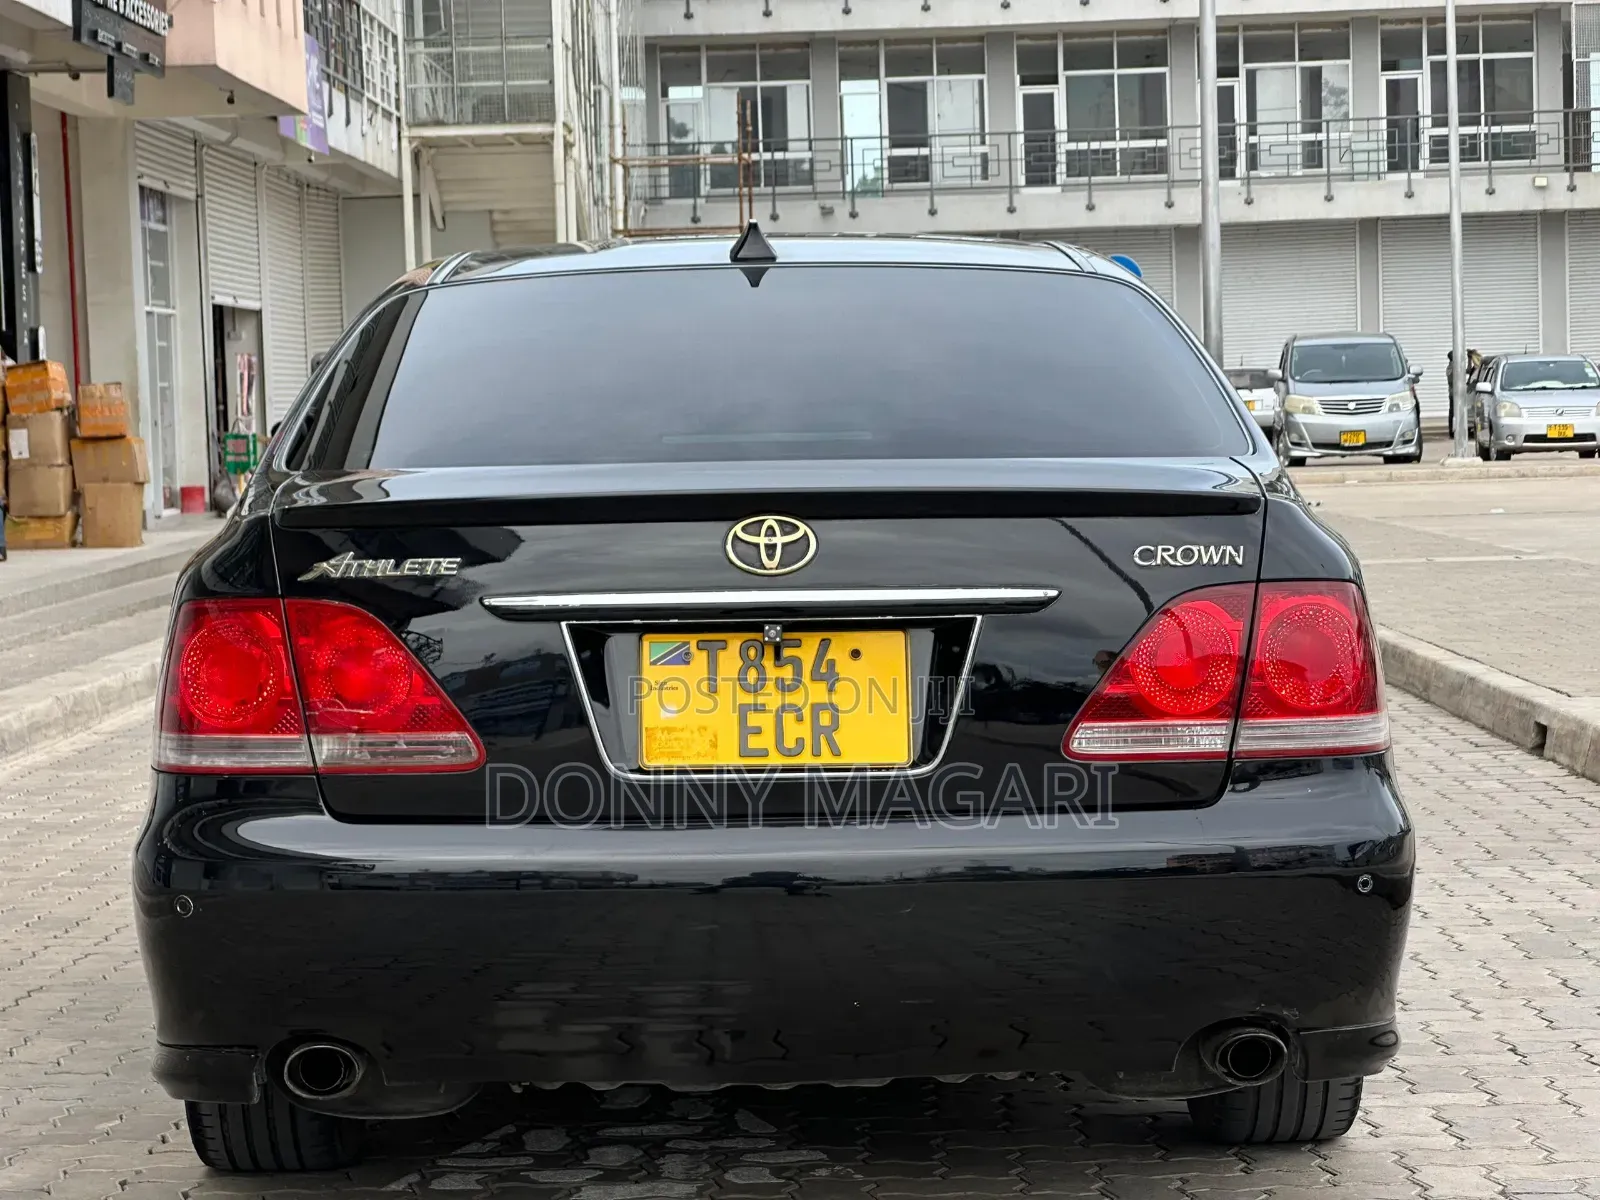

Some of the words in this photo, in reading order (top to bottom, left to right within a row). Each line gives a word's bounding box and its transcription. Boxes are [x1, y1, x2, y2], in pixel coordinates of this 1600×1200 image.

[124, 0, 169, 36] ACCESSORIES
[297, 551, 462, 582] ATHLETE
[1133, 545, 1244, 566] CROWN
[738, 702, 842, 757] ECR
